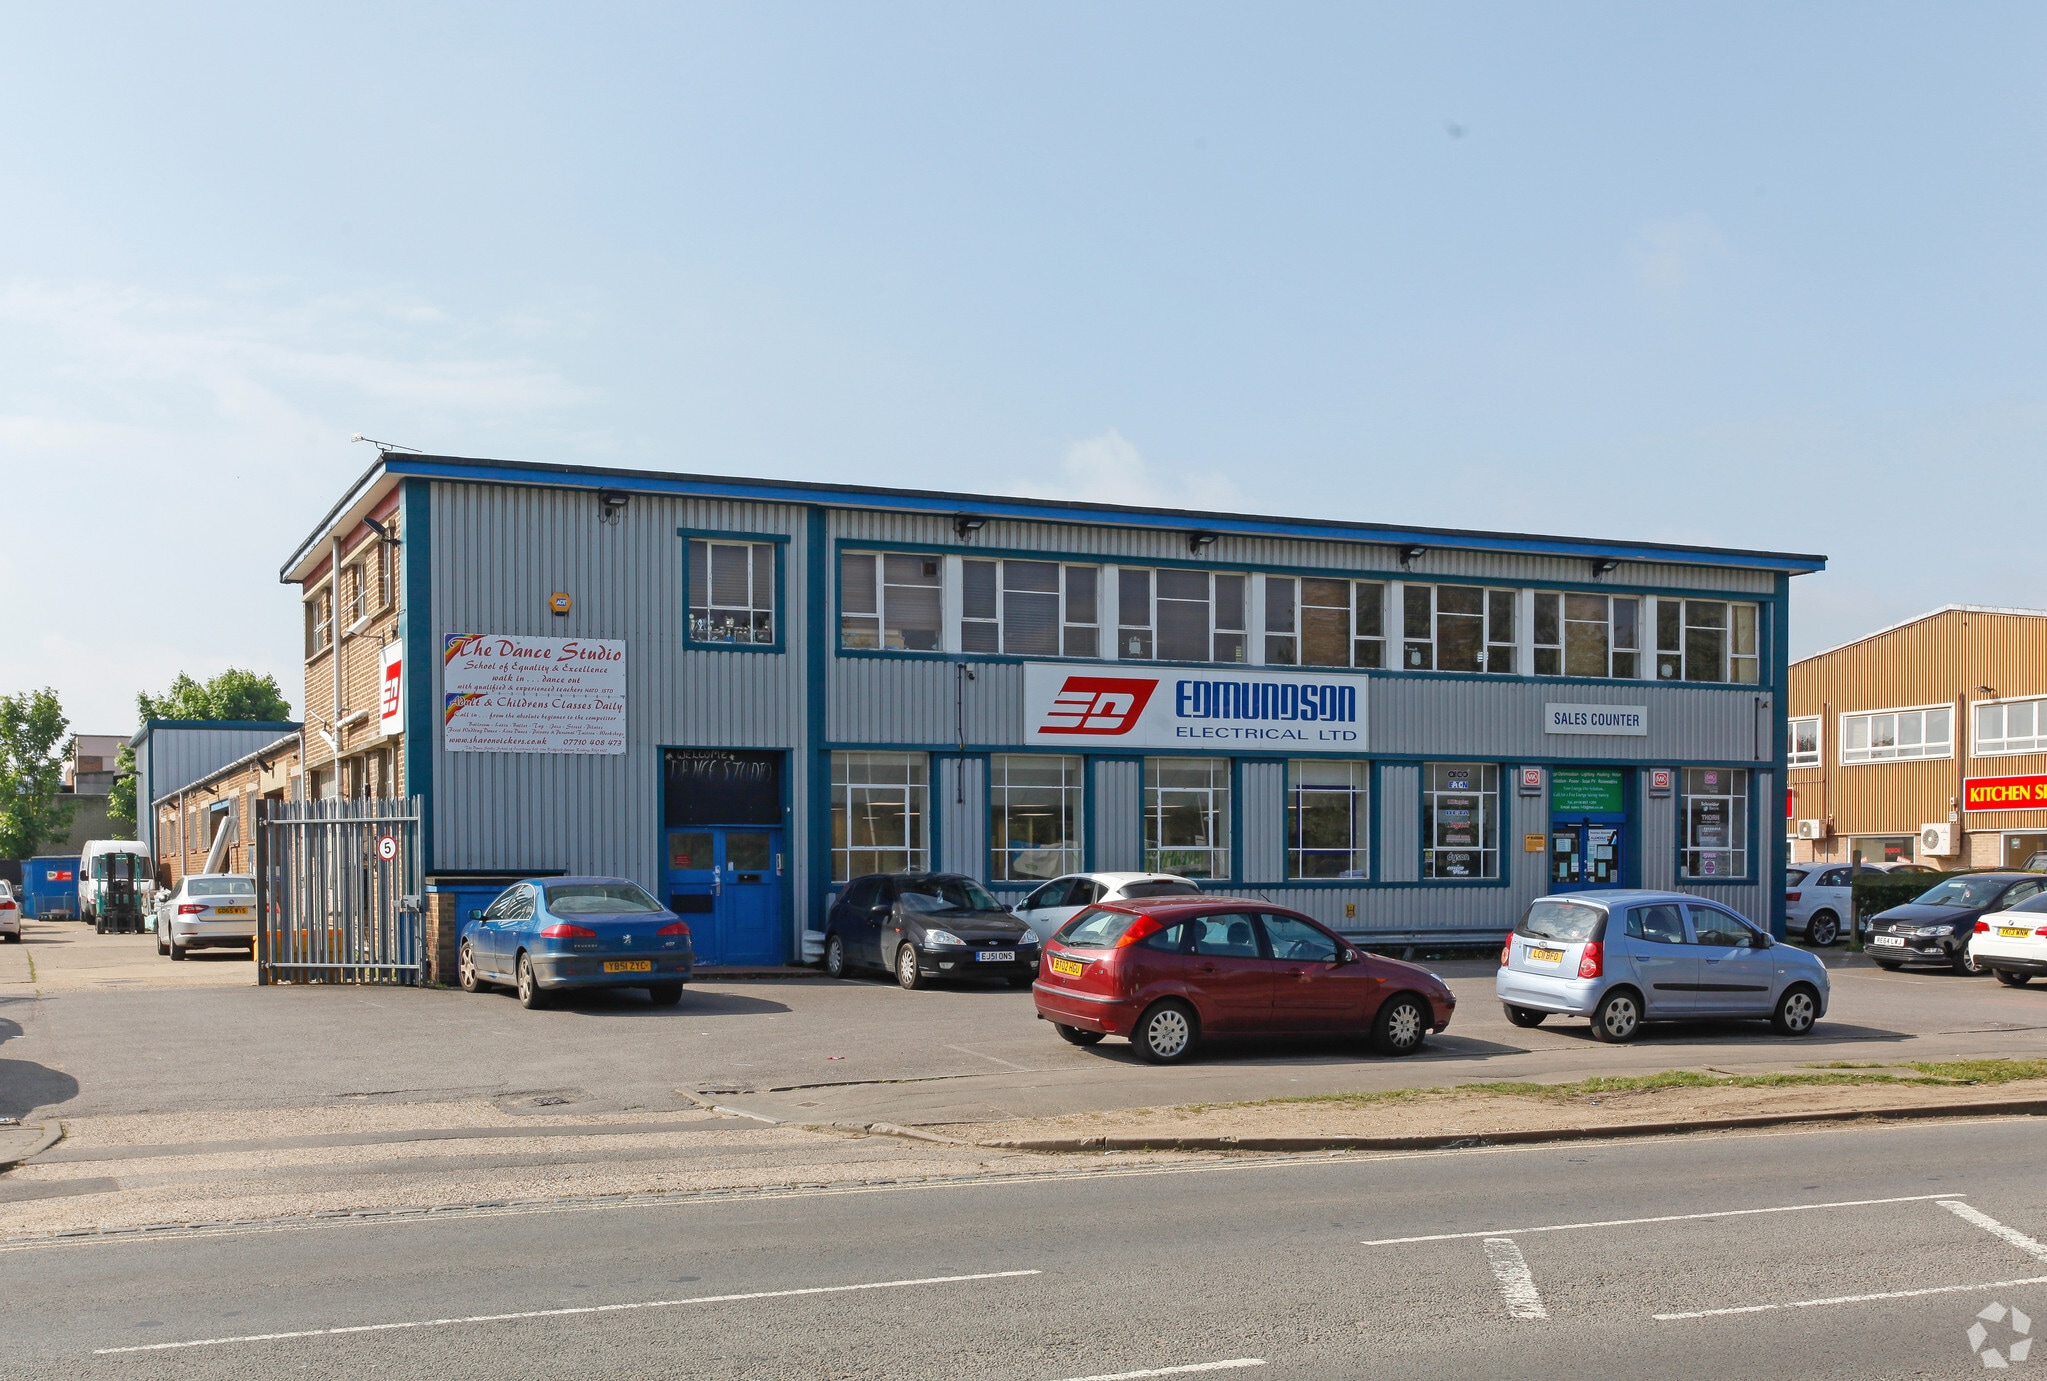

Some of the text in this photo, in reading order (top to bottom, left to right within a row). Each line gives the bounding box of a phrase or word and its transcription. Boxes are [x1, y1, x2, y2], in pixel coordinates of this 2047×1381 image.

[449, 637, 622, 662] The Dance Studio
[464, 660, 496, 670] School
[499, 662, 509, 672] of
[512, 662, 550, 674] Equality
[562, 664, 608, 674] Excellence
[492, 674, 514, 682] walk
[542, 675, 564, 684] dance
[474, 684, 506, 692] qualified
[448, 696, 480, 708] Adult
[496, 697, 548, 708] Childrens
[552, 698, 592, 710] Classes
[593, 700, 623, 714] Daily
[1176, 679, 1356, 722] EDMUNDSON
[1554, 712, 1640, 726] SALES COUNTER
[1176, 726, 1357, 742] ELECTRICAL LTD
[677, 751, 728, 760] WELCOME
[1448, 768, 1468, 778] aico
[1970, 785, 2030, 802] KITCHEN
[384, 842, 391, 854] 5
[1447, 852, 1470, 864] dyson
